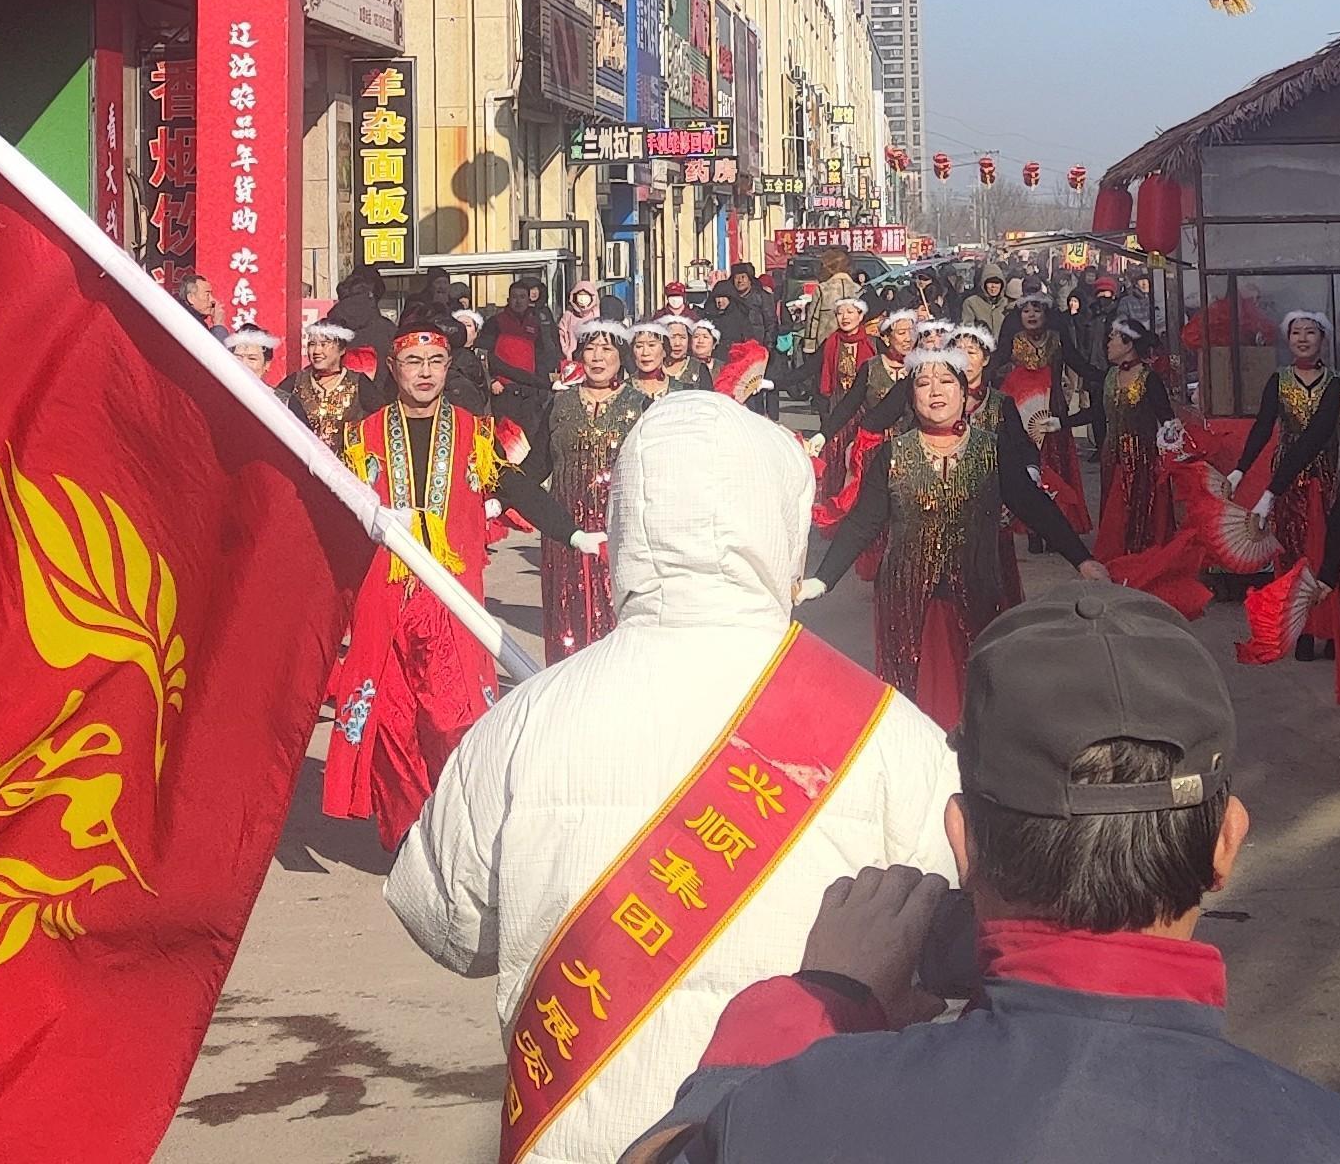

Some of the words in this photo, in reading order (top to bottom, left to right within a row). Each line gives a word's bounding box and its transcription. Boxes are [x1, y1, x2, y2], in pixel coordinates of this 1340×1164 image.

[228, 21, 259, 235] 辽沈农品年货购
[360, 67, 409, 265] 羊杂面板面
[583, 126, 644, 161] 兰州拉面
[684, 158, 738, 184] 药房
[763, 178, 805, 194] 五金日杂
[611, 762, 786, 957] 兴顺集团
